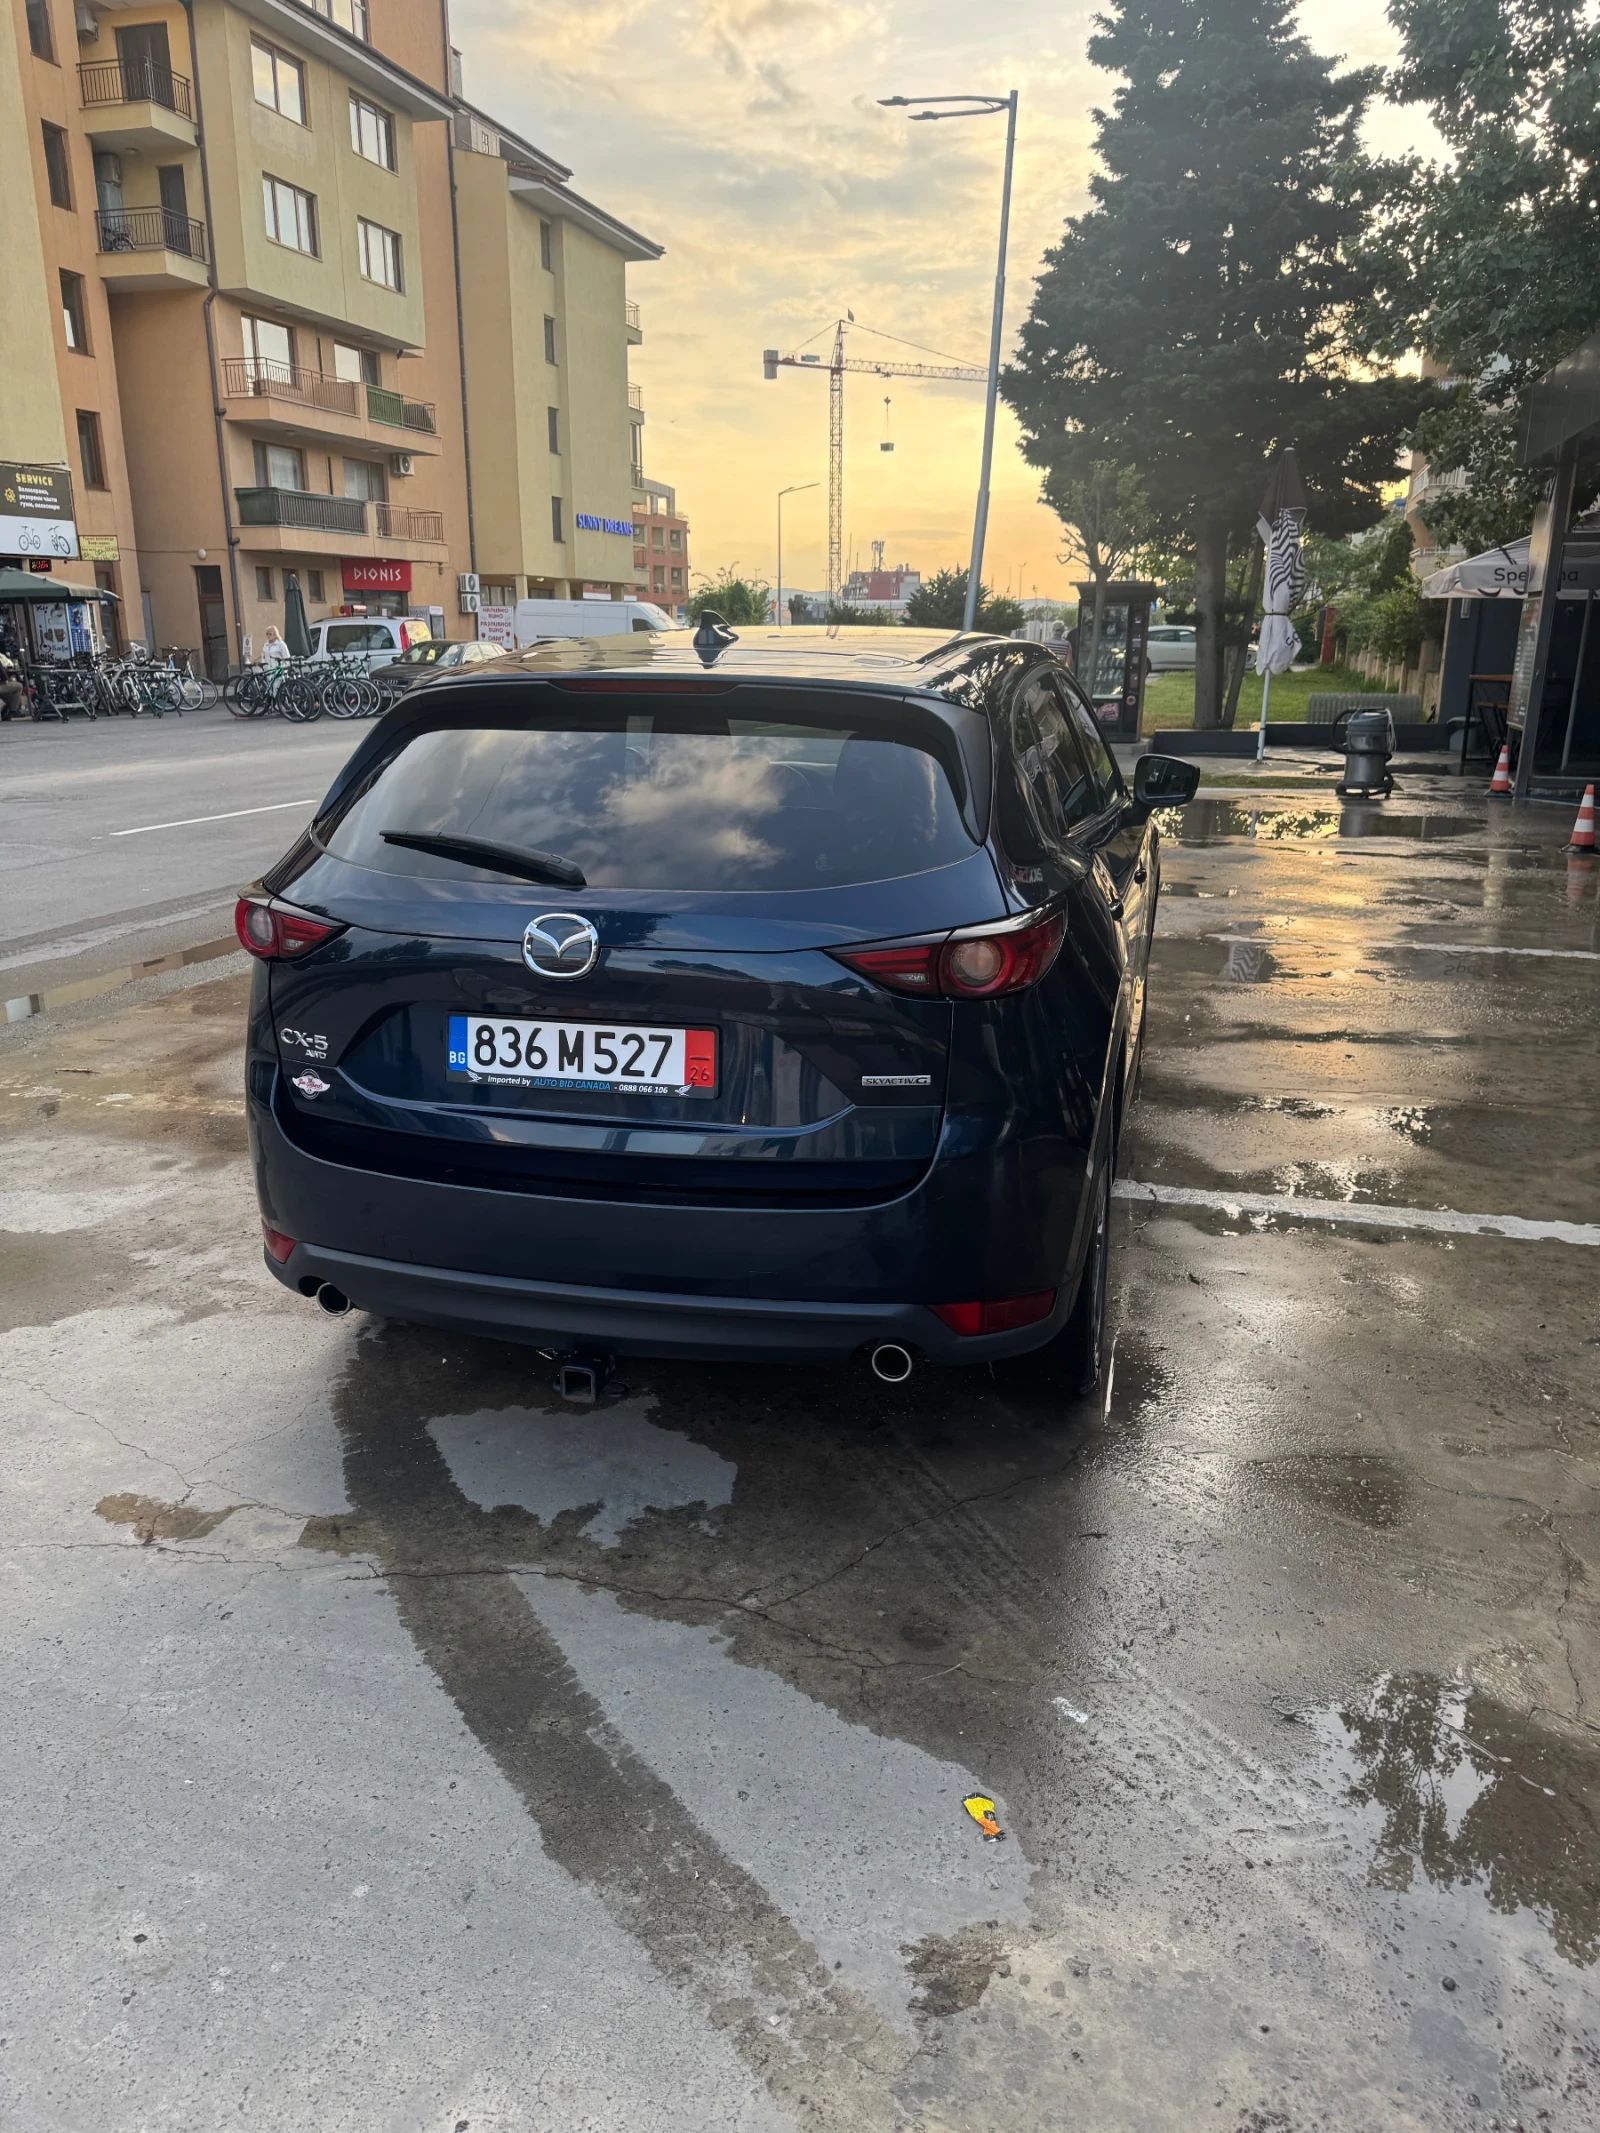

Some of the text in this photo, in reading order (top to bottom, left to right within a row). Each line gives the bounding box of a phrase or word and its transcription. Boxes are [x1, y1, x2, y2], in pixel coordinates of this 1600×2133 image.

[15, 472, 54, 487] SERVICE
[576, 513, 633, 537] SUNNY DREAMS
[353, 567, 402, 582] DIONIS
[280, 1027, 329, 1051] CX-5
[305, 1049, 327, 1060] AWD
[449, 1050, 466, 1065] BG
[474, 1024, 673, 1078] 836 M 527
[690, 1066, 710, 1082] 26
[487, 1075, 521, 1087] Imported
[521, 1076, 532, 1087] by
[533, 1078, 557, 1088] AUTO
[559, 1080, 574, 1088] BID
[575, 1081, 611, 1091] CANADA
[618, 1083, 637, 1092] 0888
[638, 1085, 653, 1093] 066
[653, 1086, 669, 1094] 106
